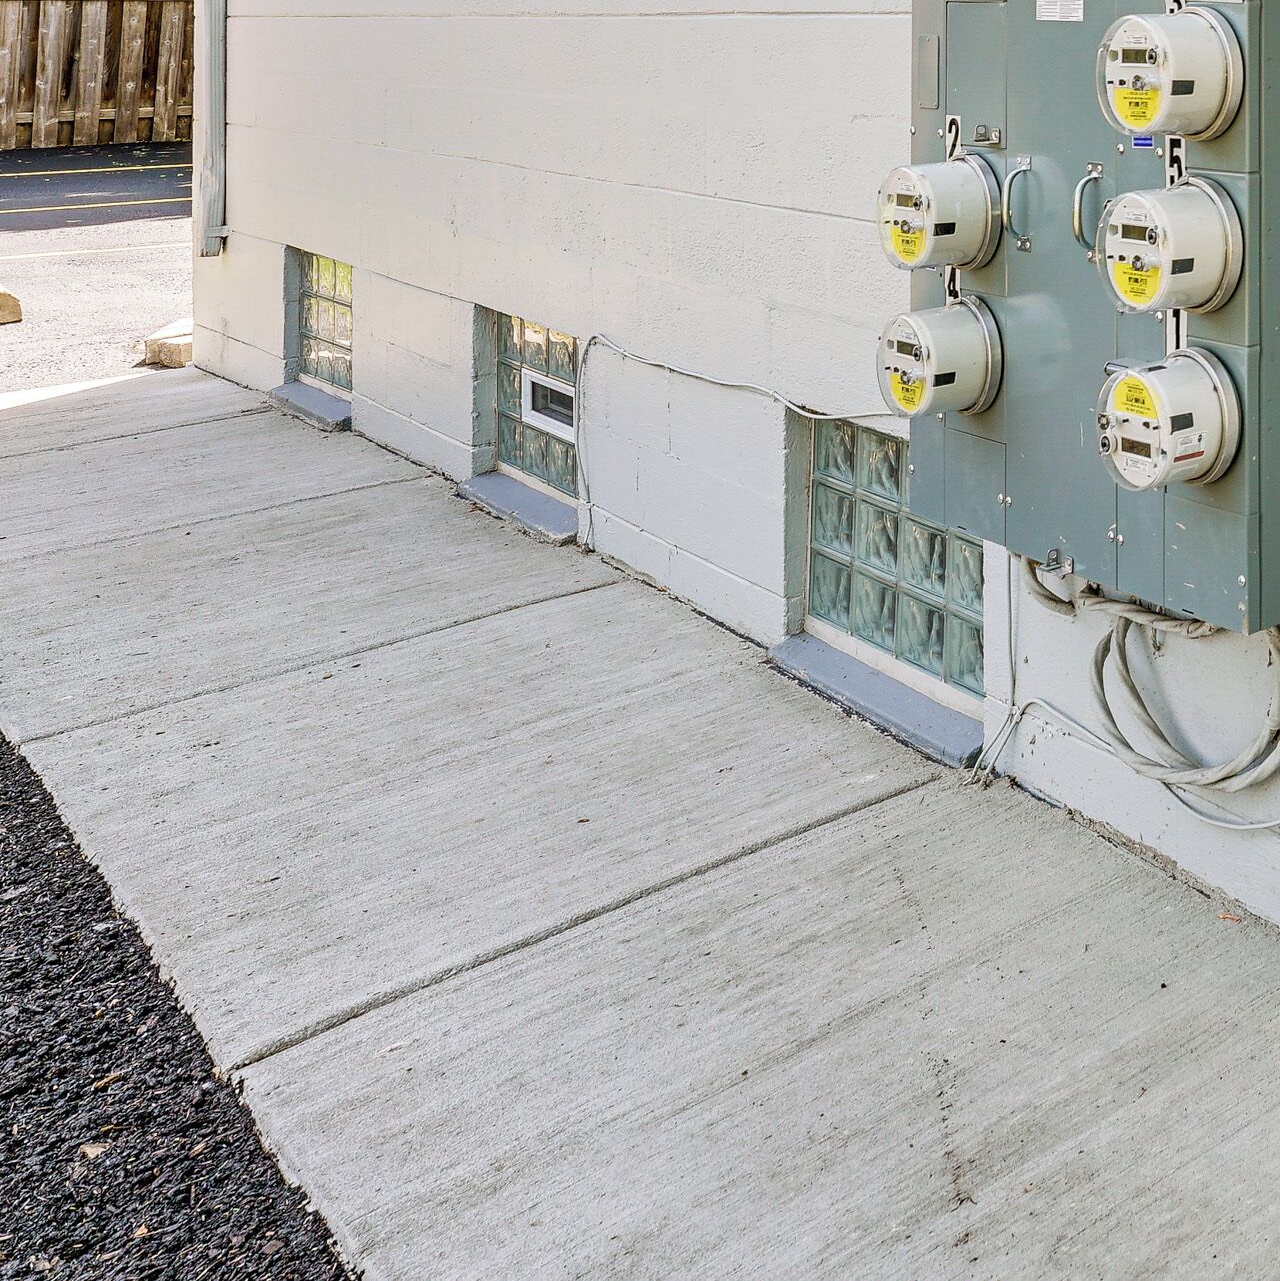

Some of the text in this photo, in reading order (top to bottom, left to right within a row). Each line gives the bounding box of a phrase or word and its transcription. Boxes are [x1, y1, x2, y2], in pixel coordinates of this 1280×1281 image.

[948, 118, 959, 159] 2
[1169, 138, 1182, 186] 5
[948, 266, 959, 299] 4
[1172, 309, 1180, 349] 1
